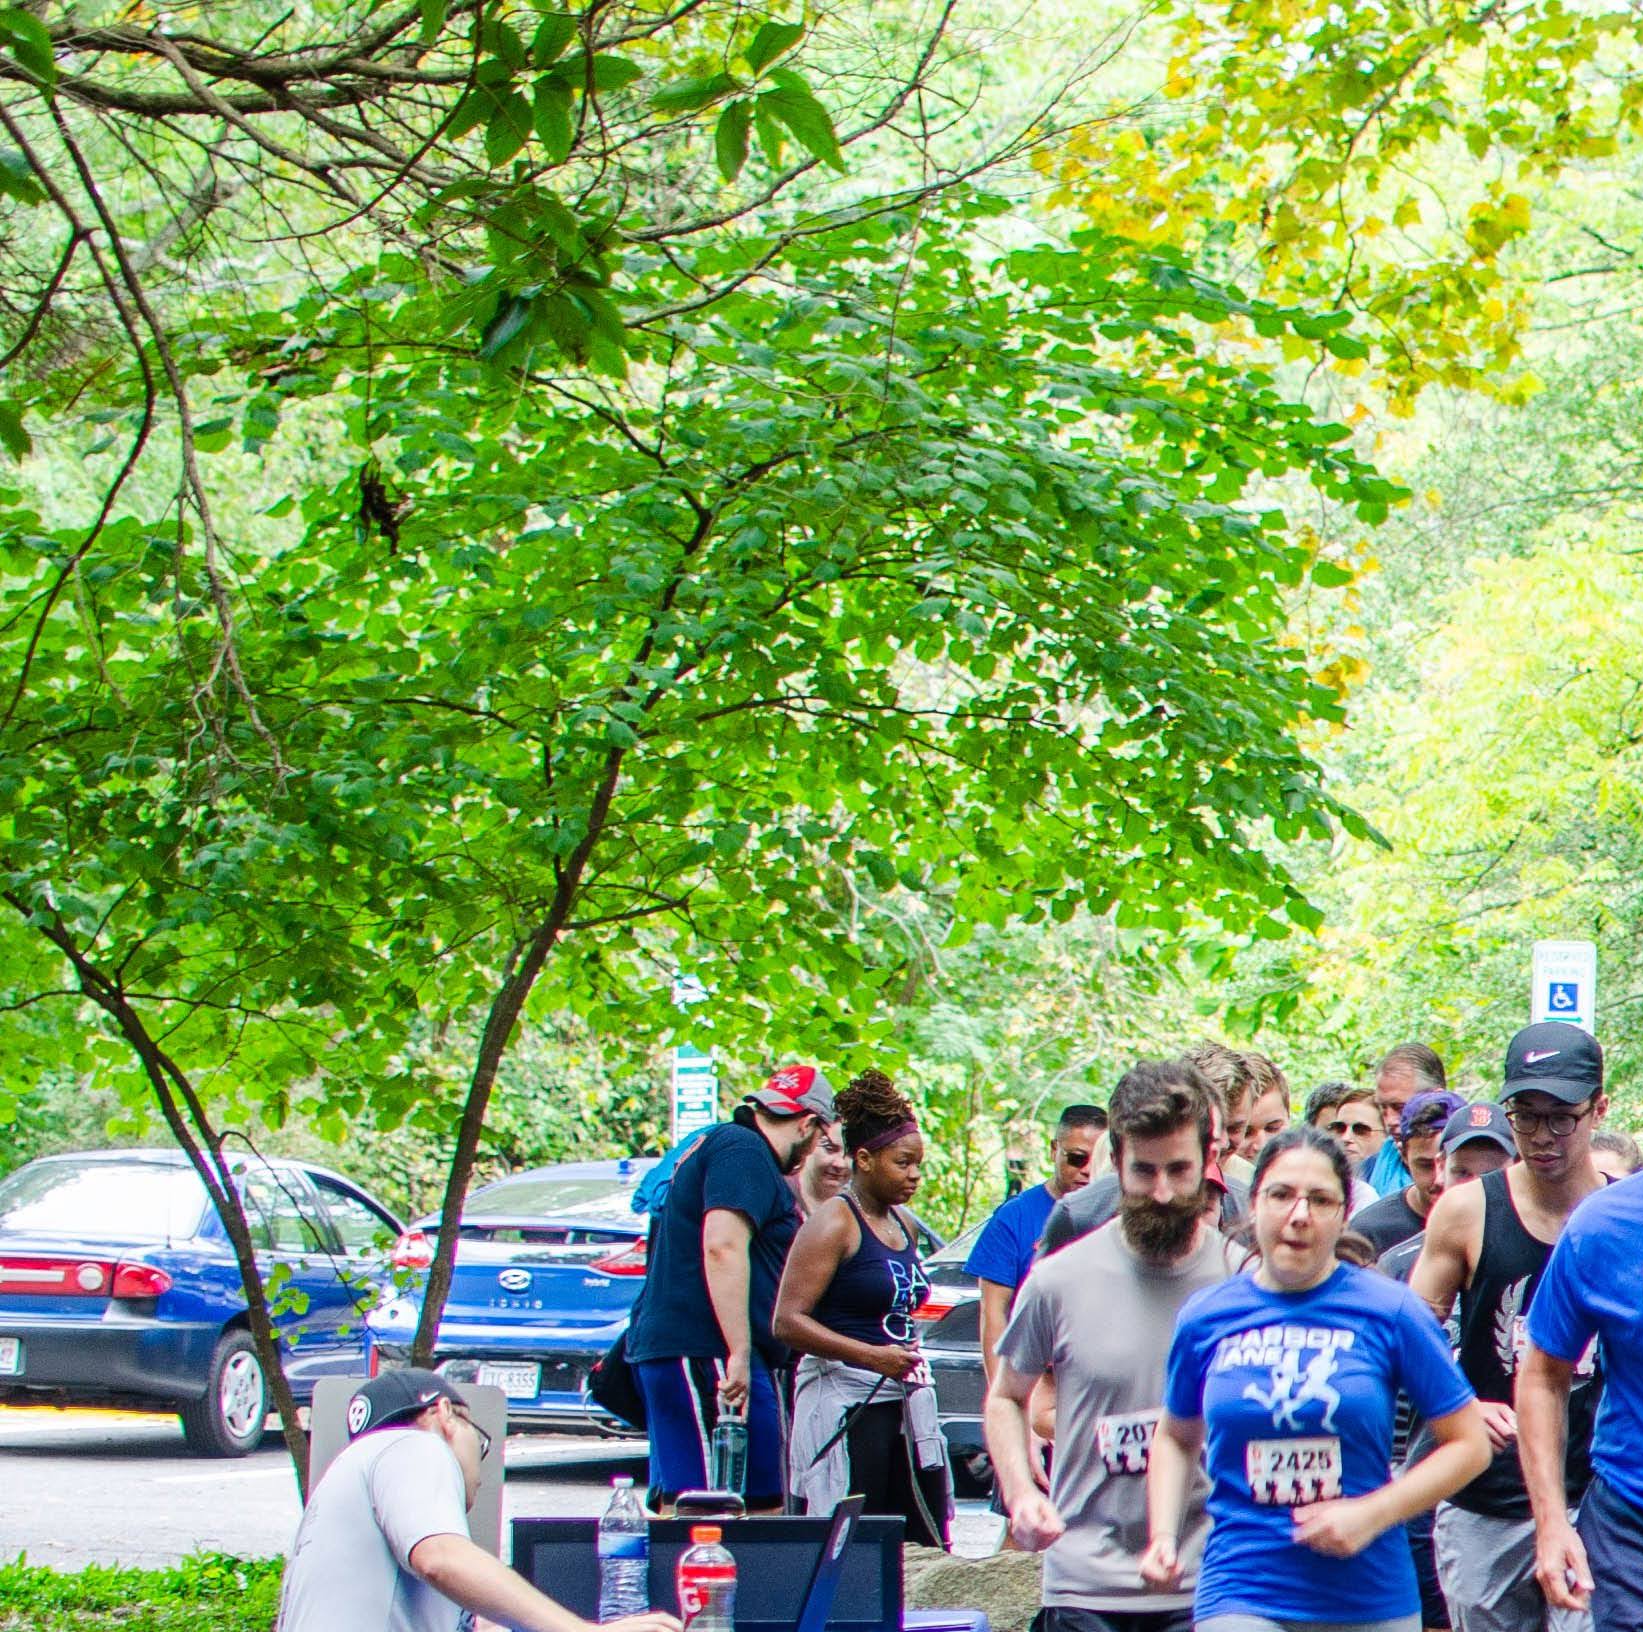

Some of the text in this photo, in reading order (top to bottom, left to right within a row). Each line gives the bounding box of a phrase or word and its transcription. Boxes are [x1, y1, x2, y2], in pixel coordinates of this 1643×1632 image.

[1217, 1325, 1355, 1351] HARBOR
[1216, 1346, 1284, 1372] LANE
[1270, 1451, 1333, 1473] 2425
